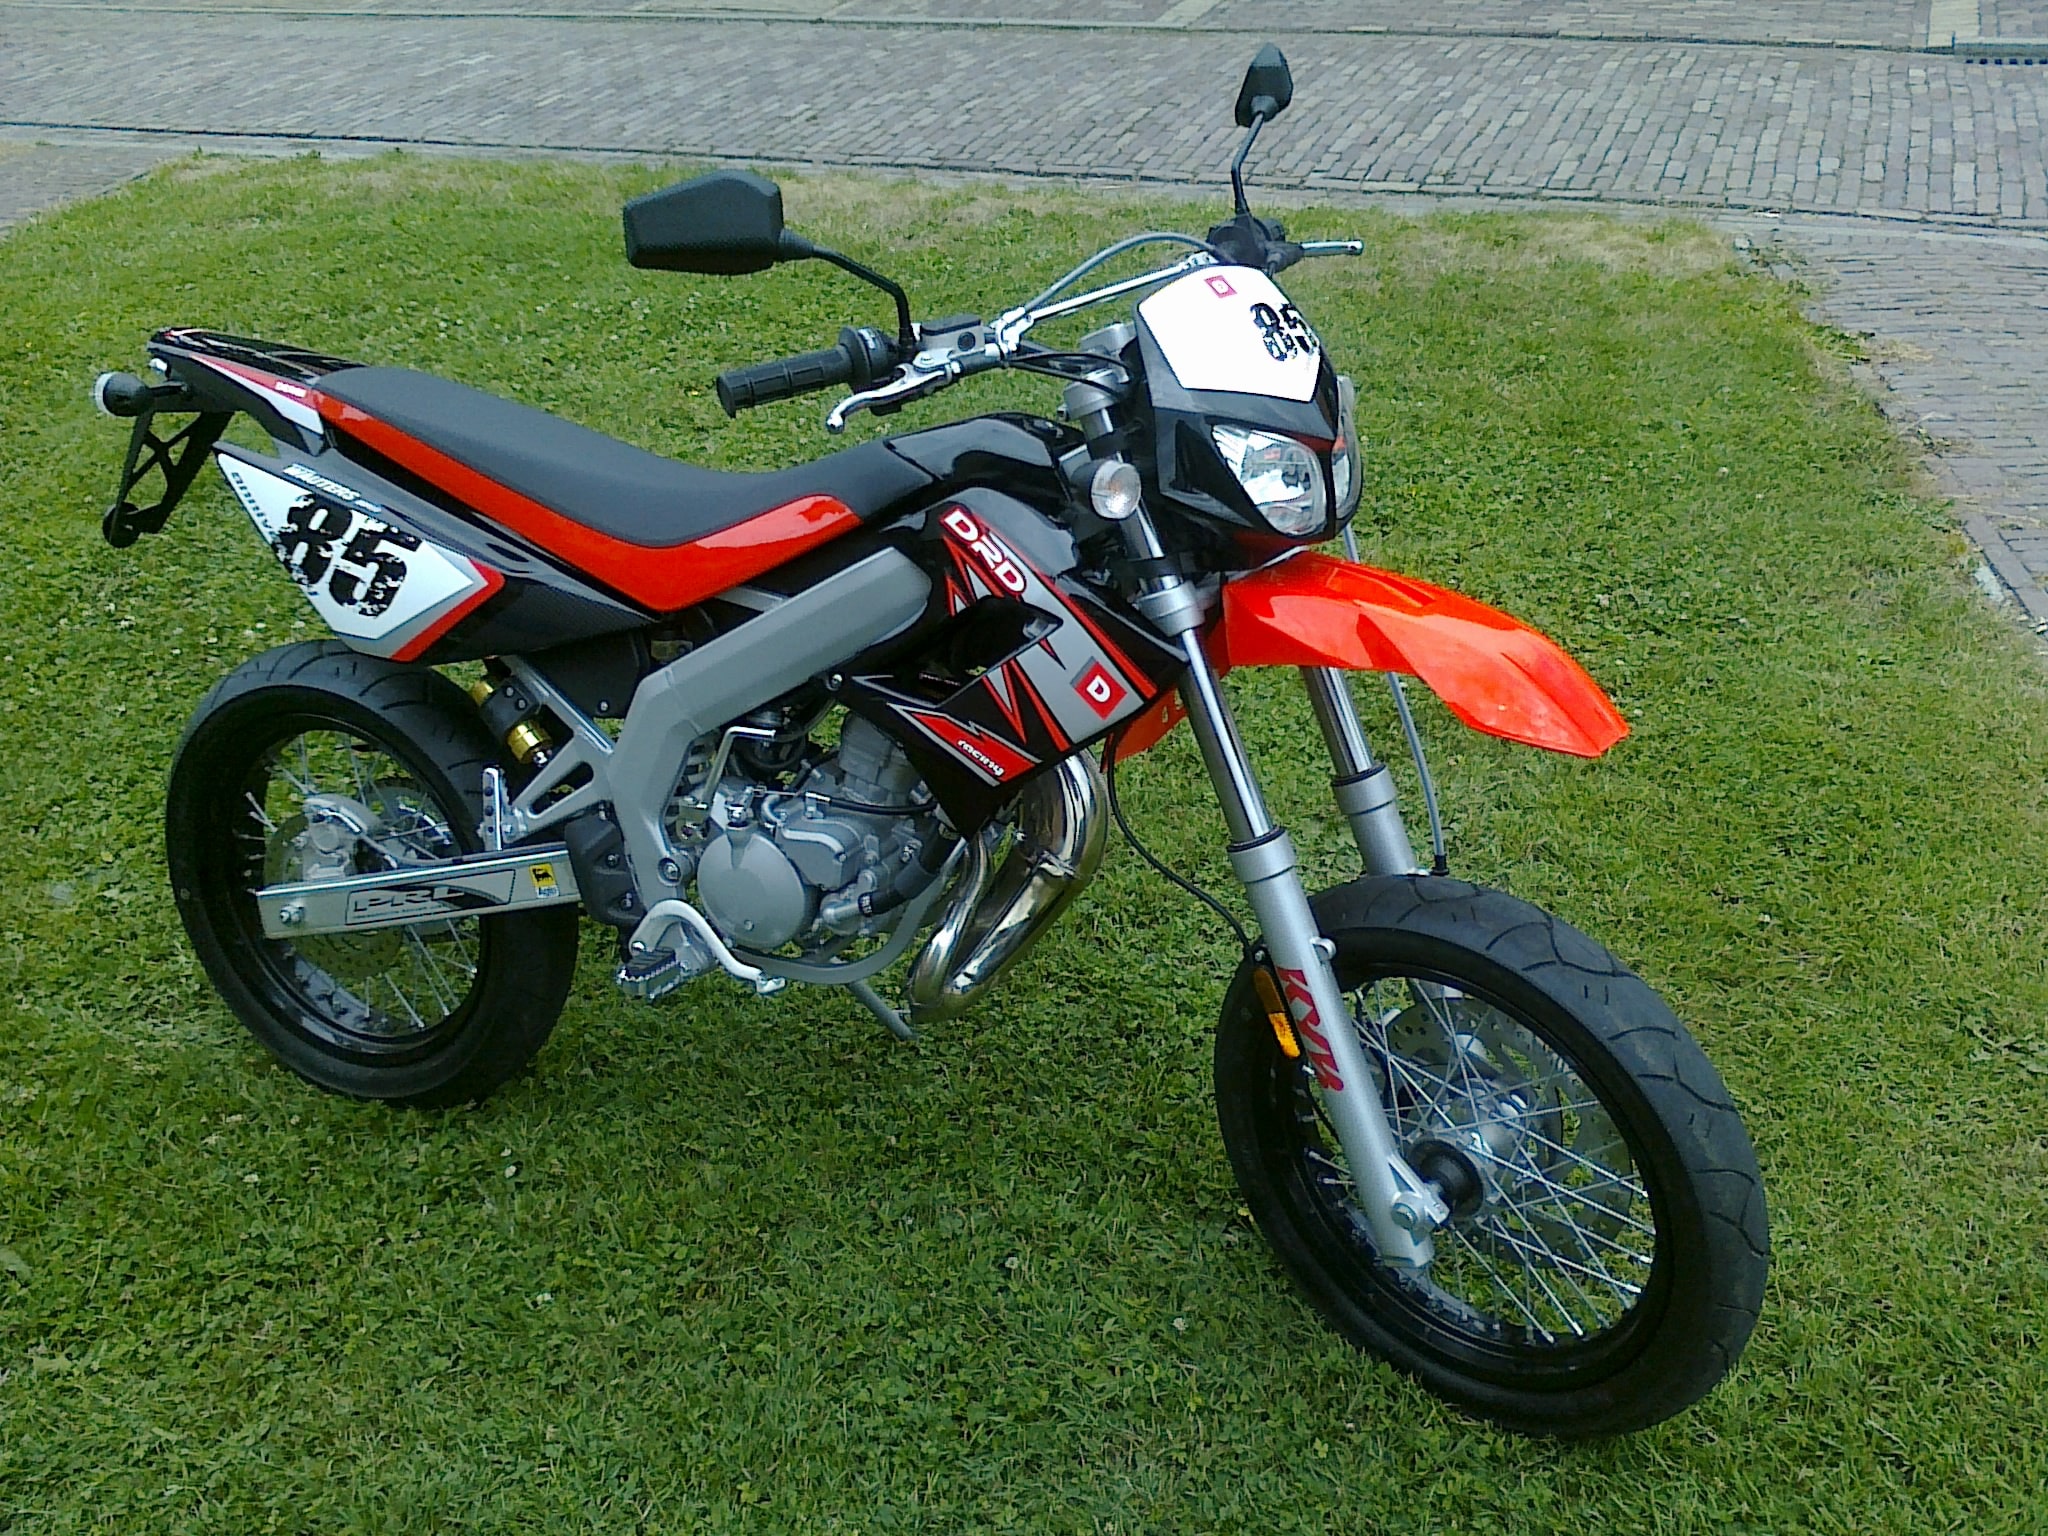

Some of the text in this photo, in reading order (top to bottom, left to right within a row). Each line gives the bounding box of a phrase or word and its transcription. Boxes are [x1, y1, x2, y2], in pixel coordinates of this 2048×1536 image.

[270, 493, 423, 618] 85
[943, 507, 1027, 592] DRD
[1086, 675, 1111, 702] D
[957, 738, 1006, 777] racing
[353, 885, 466, 912] PRL
